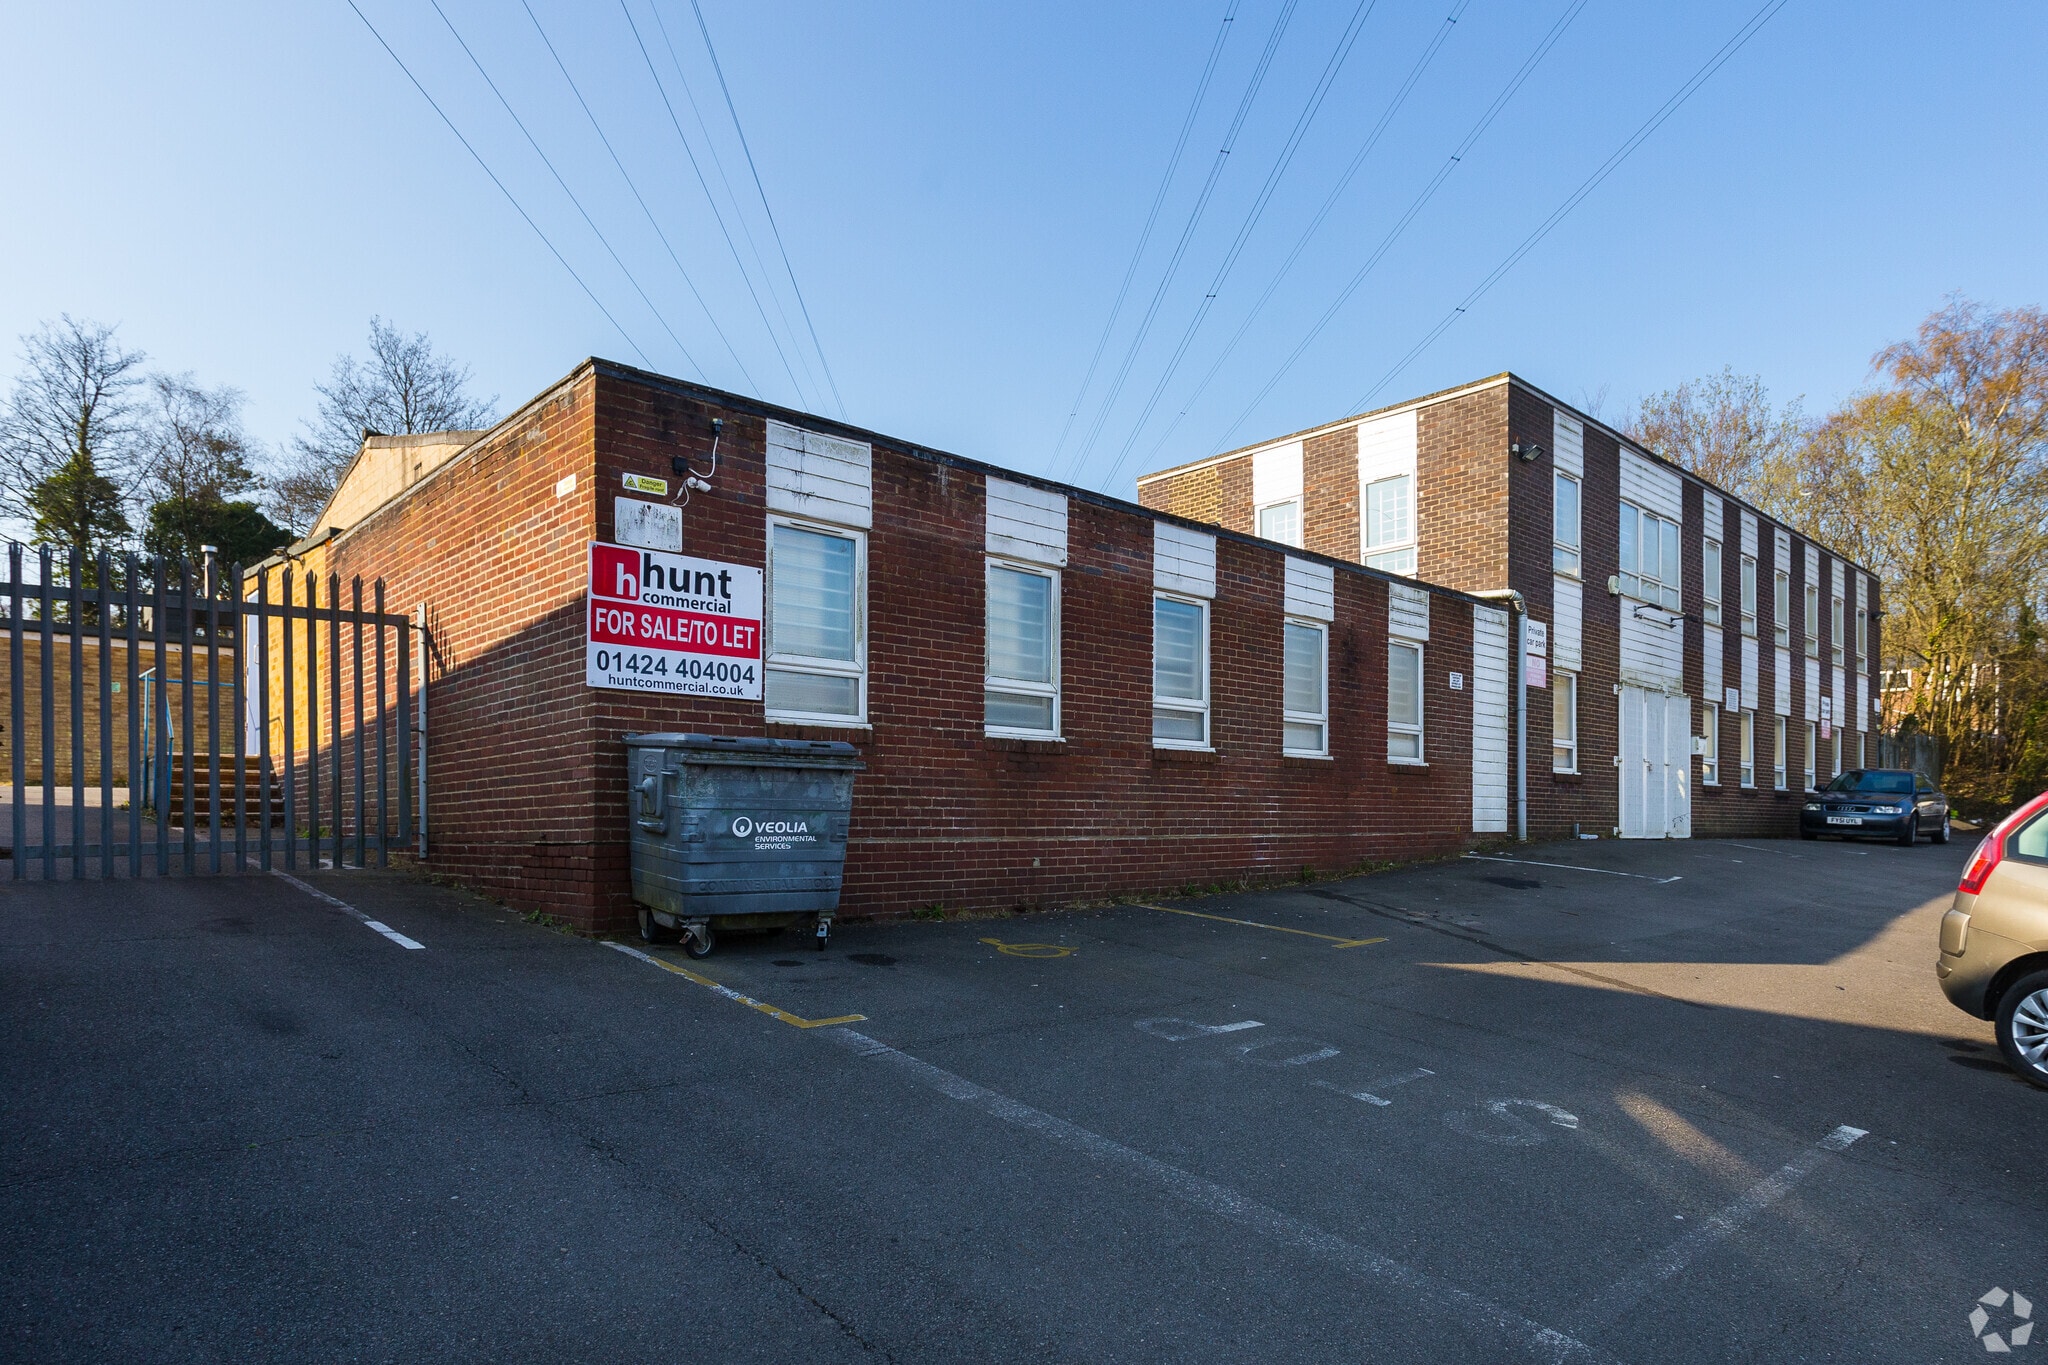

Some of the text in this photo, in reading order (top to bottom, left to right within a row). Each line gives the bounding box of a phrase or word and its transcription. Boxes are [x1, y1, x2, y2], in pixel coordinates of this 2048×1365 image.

[641, 478, 662, 487] Danger
[616, 562, 636, 596] h
[643, 552, 732, 599] hunt
[642, 591, 731, 614] commercial
[595, 607, 755, 649] FOR SALE/TO LET
[1528, 625, 1545, 637] Private
[1527, 638, 1545, 648] car park
[596, 650, 755, 684] 01424 404004
[608, 674, 744, 696] huntcommercial.co.uk
[755, 821, 808, 833] VEOLIA
[754, 842, 792, 850] SERVICES
